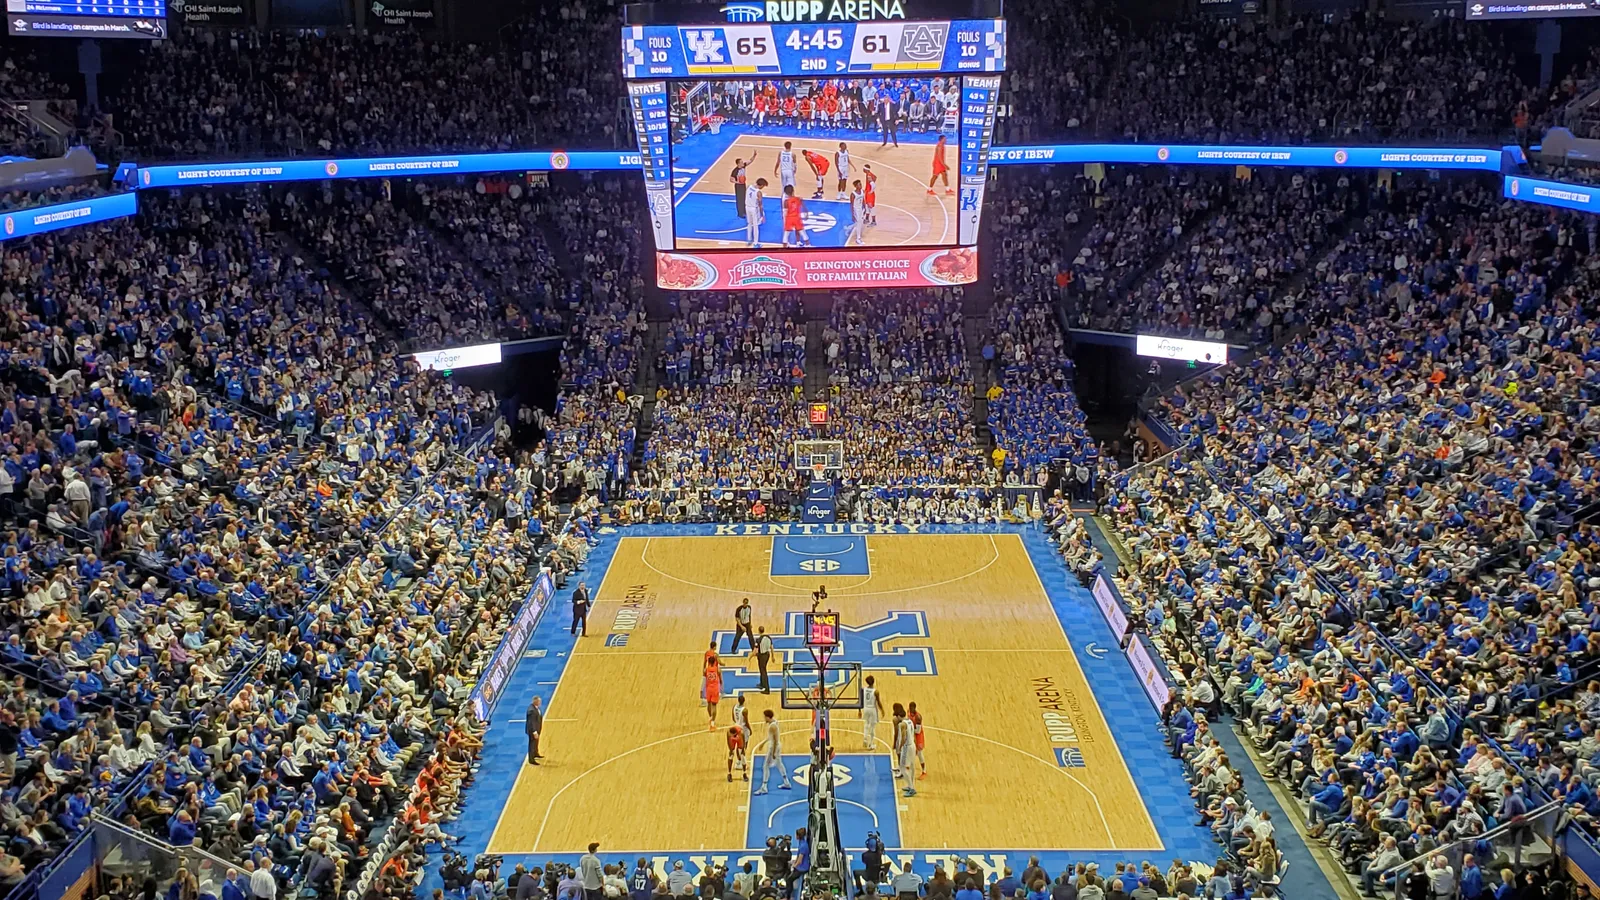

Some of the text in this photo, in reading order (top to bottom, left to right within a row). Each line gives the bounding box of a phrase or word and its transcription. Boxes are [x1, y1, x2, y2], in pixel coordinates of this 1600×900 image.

[198, 5, 216, 13] Saint
[218, 6, 242, 14] Joseph
[766, 0, 906, 22] RUPP ARENA
[1536, 4, 1560, 12] campus
[185, 13, 210, 21] Health
[412, 10, 433, 18] Joseph
[51, 22, 73, 31] landing
[81, 24, 104, 32] campus
[649, 37, 672, 48] FOULS
[786, 30, 843, 50] 4:45
[957, 32, 980, 43] FOULS
[736, 38, 766, 55] 65
[862, 36, 890, 53] 61
[652, 52, 667, 62] 10
[961, 46, 976, 57] 10
[801, 60, 827, 70] 2ND
[634, 84, 661, 94] STATS
[968, 105, 984, 113] 2/10
[1007, 150, 1023, 160] OF
[1024, 150, 1055, 159] IBEW
[1381, 154, 1410, 162] LIGHTS
[1411, 154, 1454, 162] COURTESY
[396, 162, 431, 170] COURTESY
[178, 167, 282, 179] LIGHTS COURTESY OF IBEW
[737, 262, 786, 278] LaRosa's
[804, 260, 910, 270] LEXINGTON'S CHOICE
[807, 270, 908, 281] FOR FAMILY ITALIAN
[1158, 339, 1183, 356] Kroger
[435, 351, 460, 367] Kroger
[811, 411, 825, 422] 30
[808, 506, 830, 518] Kroger
[714, 524, 923, 535] KENTUCKY
[799, 559, 840, 572] SEC
[612, 584, 648, 630] RUPP ARENA
[812, 625, 832, 643] 30
[1031, 676, 1079, 742] RUPP ARENA
[792, 763, 852, 787] SC
[635, 879, 646, 891] 07
